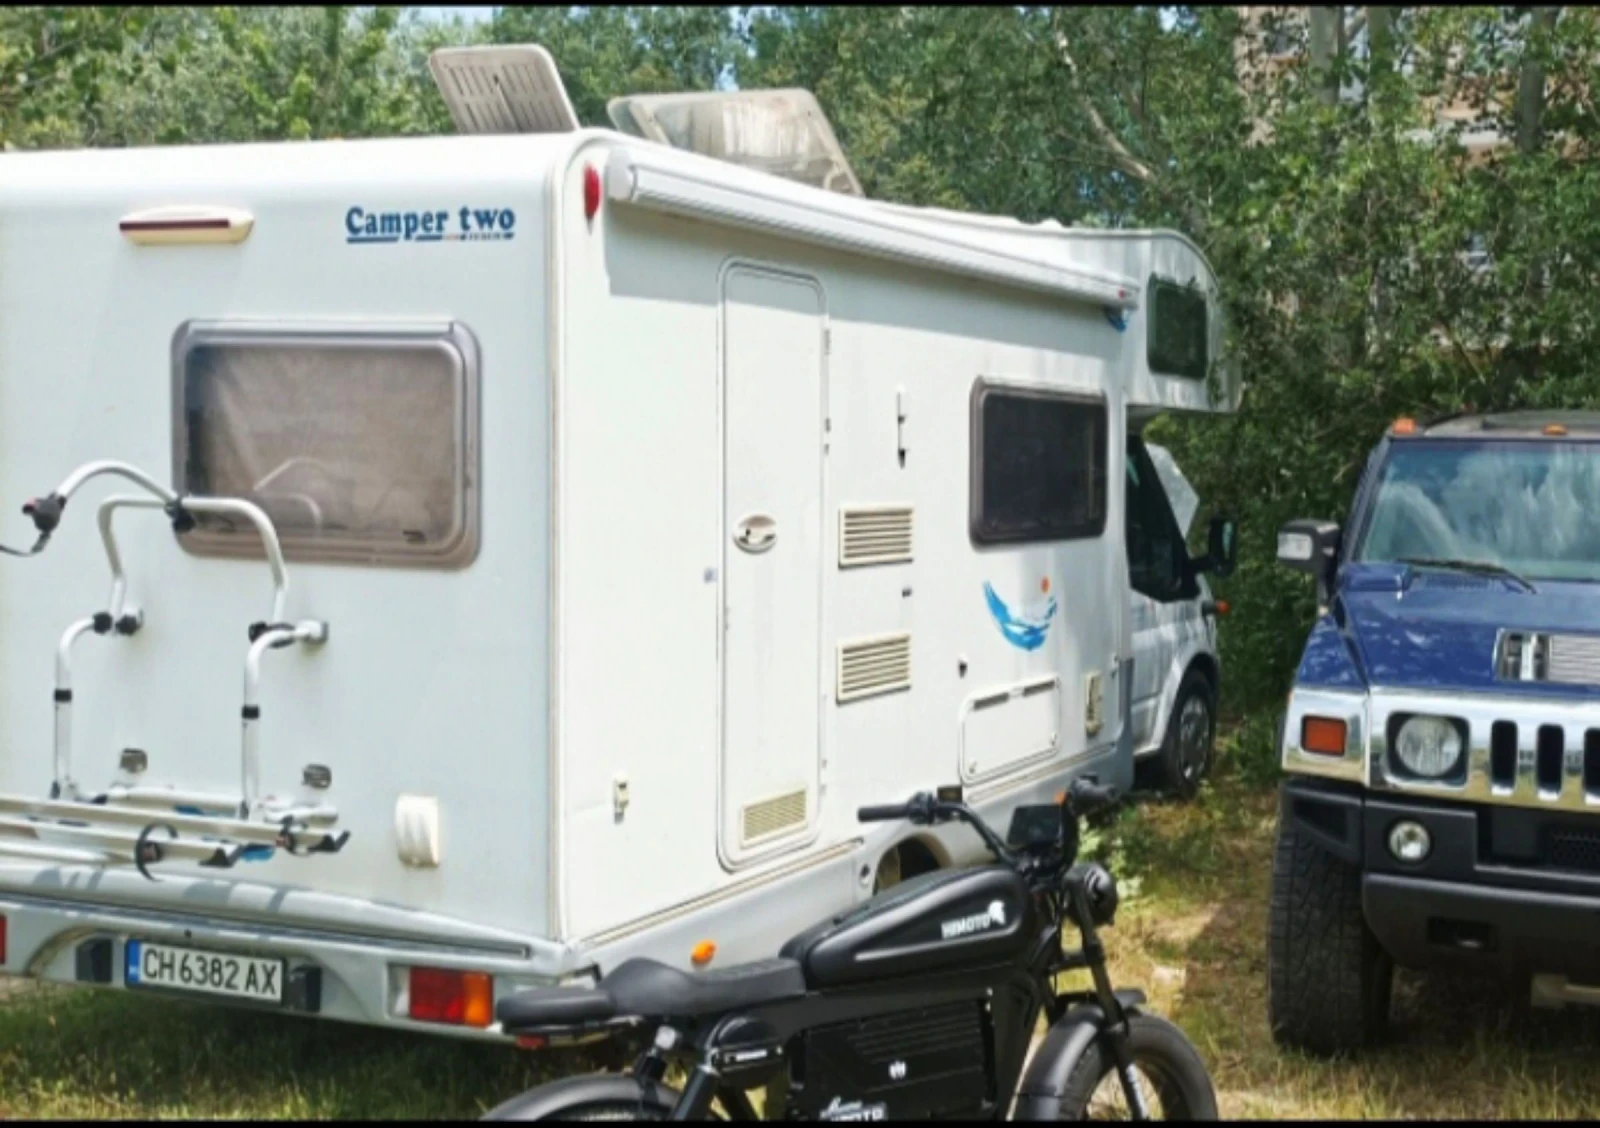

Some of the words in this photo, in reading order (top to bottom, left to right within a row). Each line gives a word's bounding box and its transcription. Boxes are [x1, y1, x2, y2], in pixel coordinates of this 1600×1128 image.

[345, 206, 448, 241] Camper
[459, 206, 515, 231] two
[144, 949, 176, 982] CH
[179, 953, 240, 990] 6382
[245, 962, 277, 995] AX
